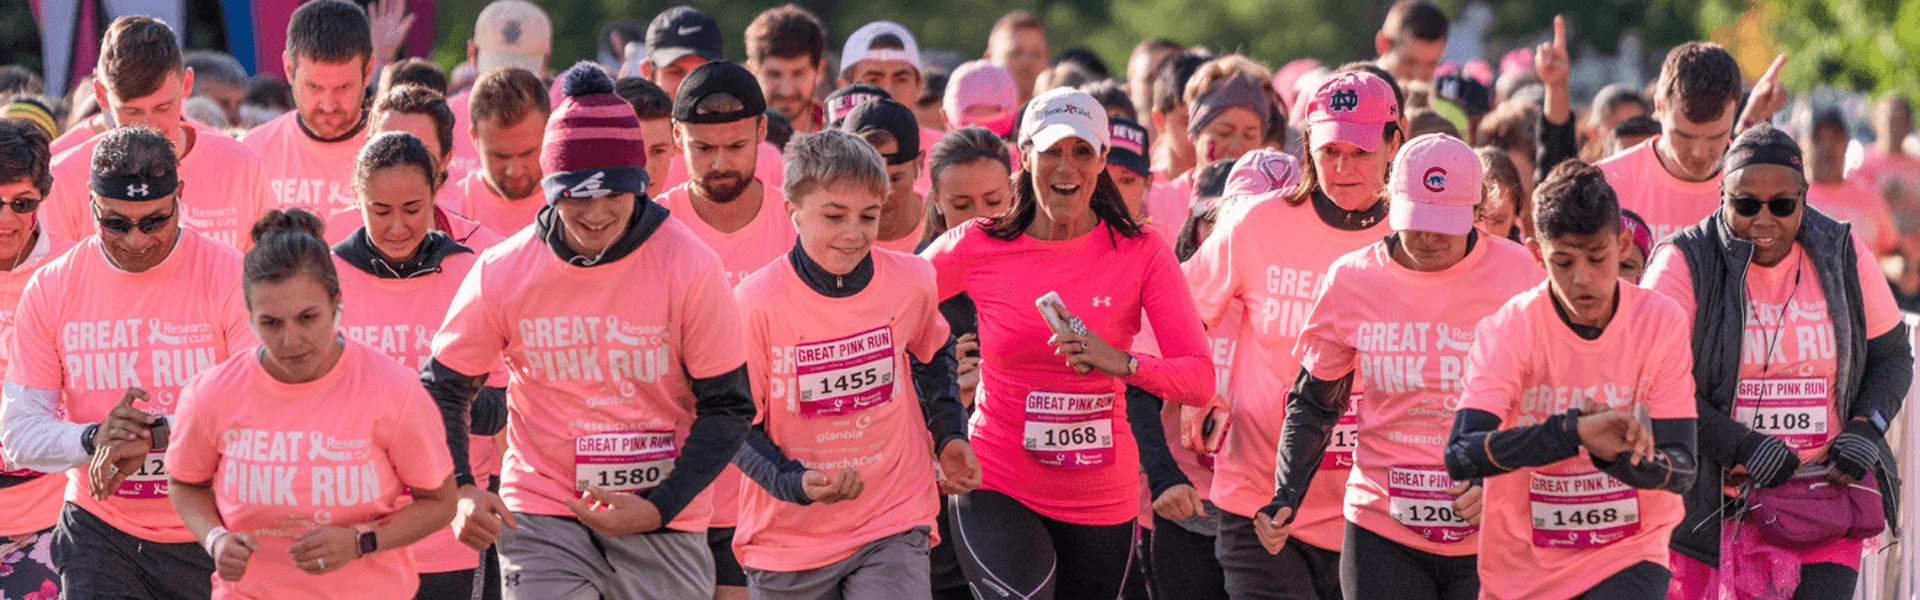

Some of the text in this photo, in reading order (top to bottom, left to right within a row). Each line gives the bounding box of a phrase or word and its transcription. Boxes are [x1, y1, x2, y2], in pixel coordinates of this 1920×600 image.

[1113, 124, 1143, 145] IEVE
[271, 179, 324, 205] REAT
[1266, 264, 1326, 301] GREA
[1262, 297, 1313, 337] PIN
[1746, 300, 1785, 326] EAT
[63, 318, 143, 351] GREAT
[163, 322, 212, 334] Research
[189, 334, 213, 344] cure
[519, 315, 600, 348] GREAT
[1357, 321, 1430, 352] GREAT
[797, 345, 836, 363] GREAT
[839, 338, 865, 357] PINK
[867, 331, 890, 350] RUN
[1743, 322, 1836, 364] NK RU
[64, 350, 142, 391] PINK
[521, 346, 604, 382] PINK
[1360, 351, 1428, 394] PINK
[820, 367, 878, 395] 1455
[1739, 382, 1826, 396] GREAT PINK RUN
[1028, 395, 1065, 410] GREAT
[1068, 397, 1093, 411] PINK
[1755, 412, 1810, 430] 1108
[224, 428, 304, 462] GREAT
[578, 437, 617, 452] GREAT
[621, 436, 648, 452] PINK
[816, 429, 863, 443] glanbia
[1044, 426, 1097, 446] 1068
[1388, 431, 1450, 445] #Research
[136, 459, 166, 476] 12
[597, 466, 660, 487] 1580
[1391, 470, 1425, 487] GREAT
[223, 459, 381, 507] PINK RUN
[1531, 477, 1570, 493] GREAT
[1574, 476, 1604, 493] PINK
[1553, 508, 1618, 527] 1468
